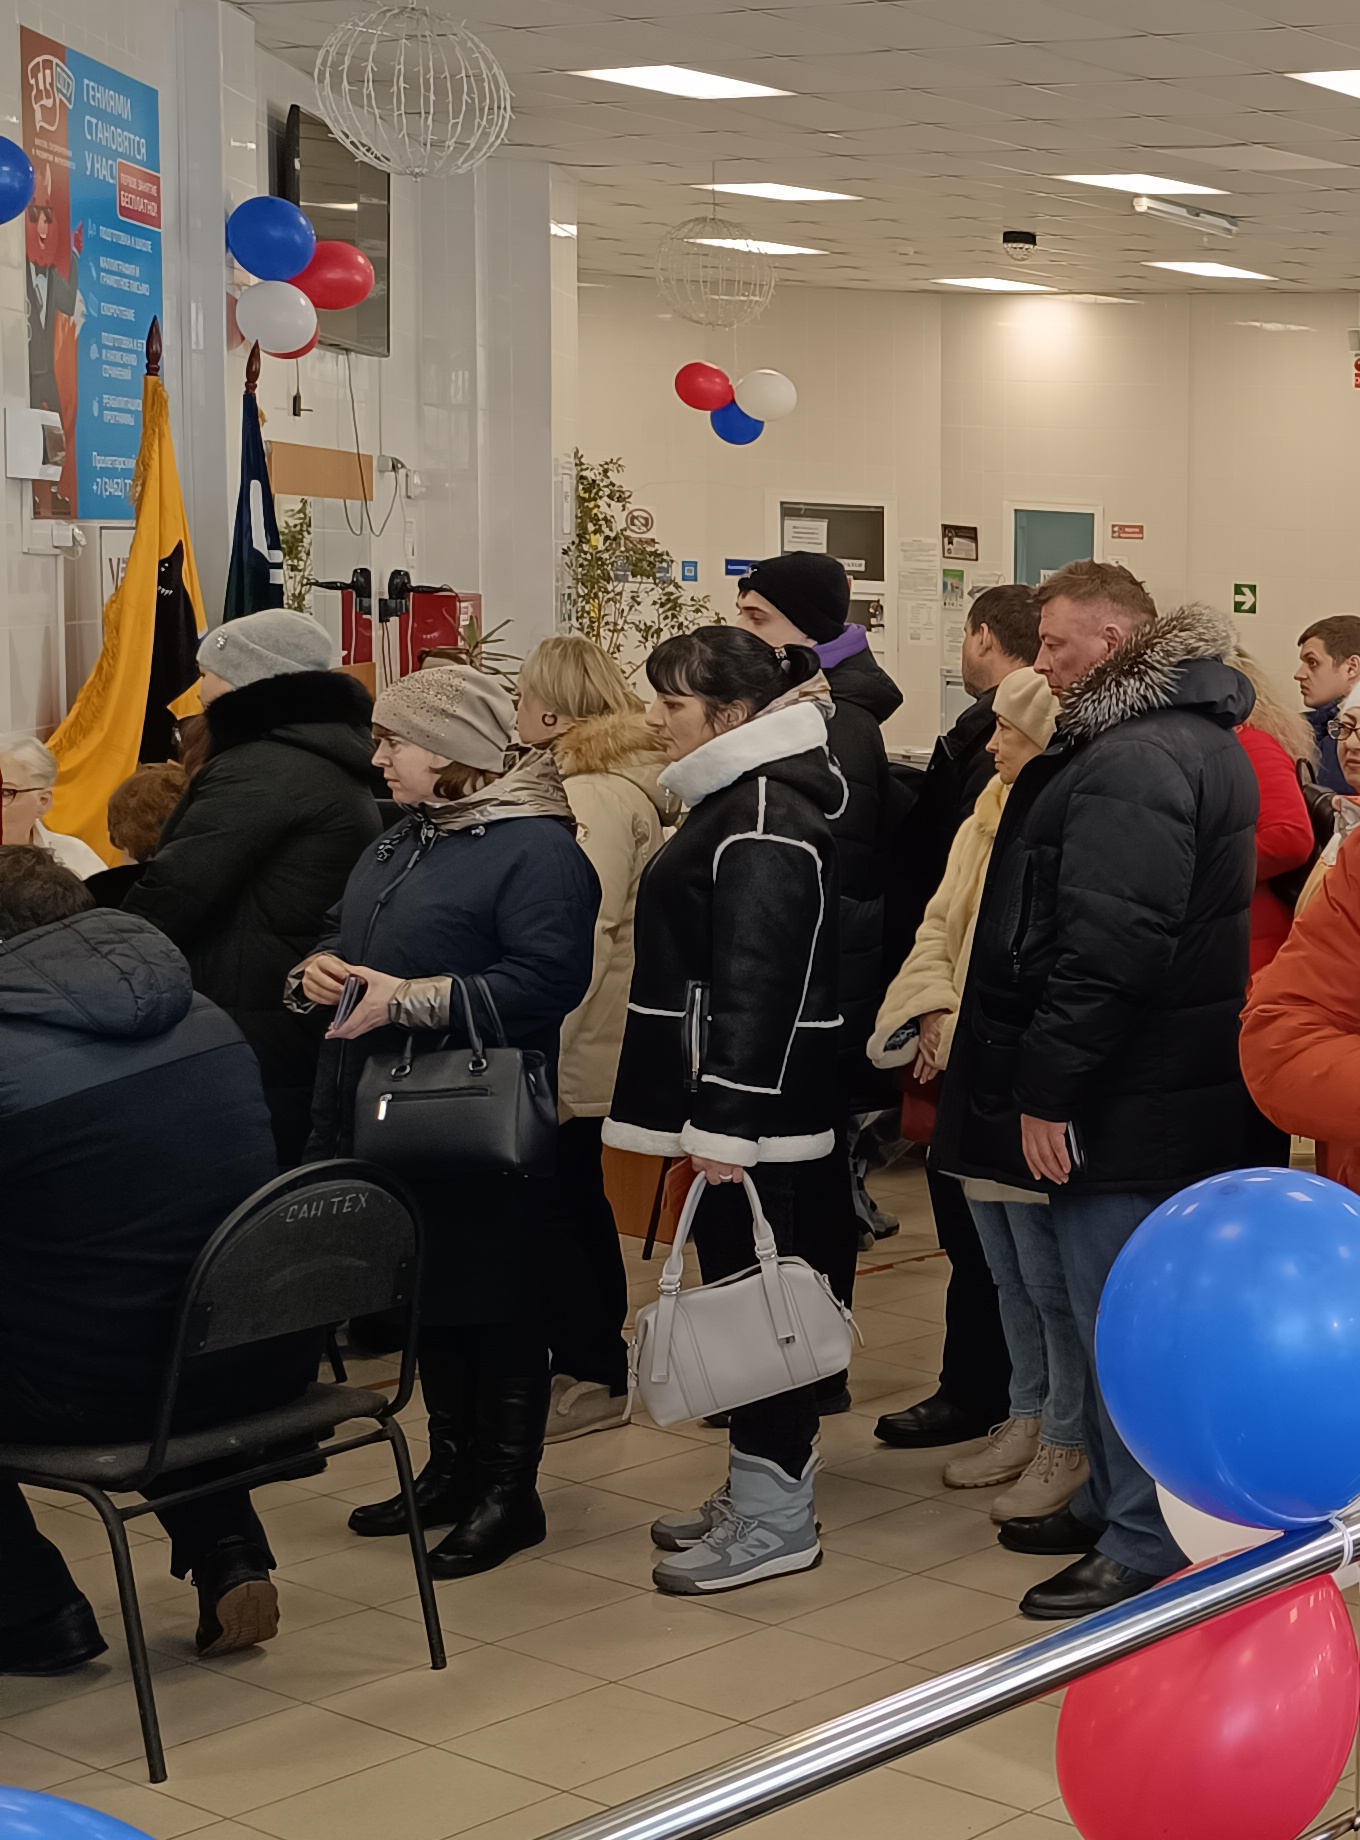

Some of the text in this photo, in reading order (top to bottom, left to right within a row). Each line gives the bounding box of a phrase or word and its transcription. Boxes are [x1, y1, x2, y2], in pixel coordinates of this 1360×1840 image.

[84, 78, 132, 121] ГЕНИЯМИ
[84, 115, 147, 162] СТАНОВЯТСЯ
[85, 151, 93, 175] У
[94, 154, 116, 184] НАС!
